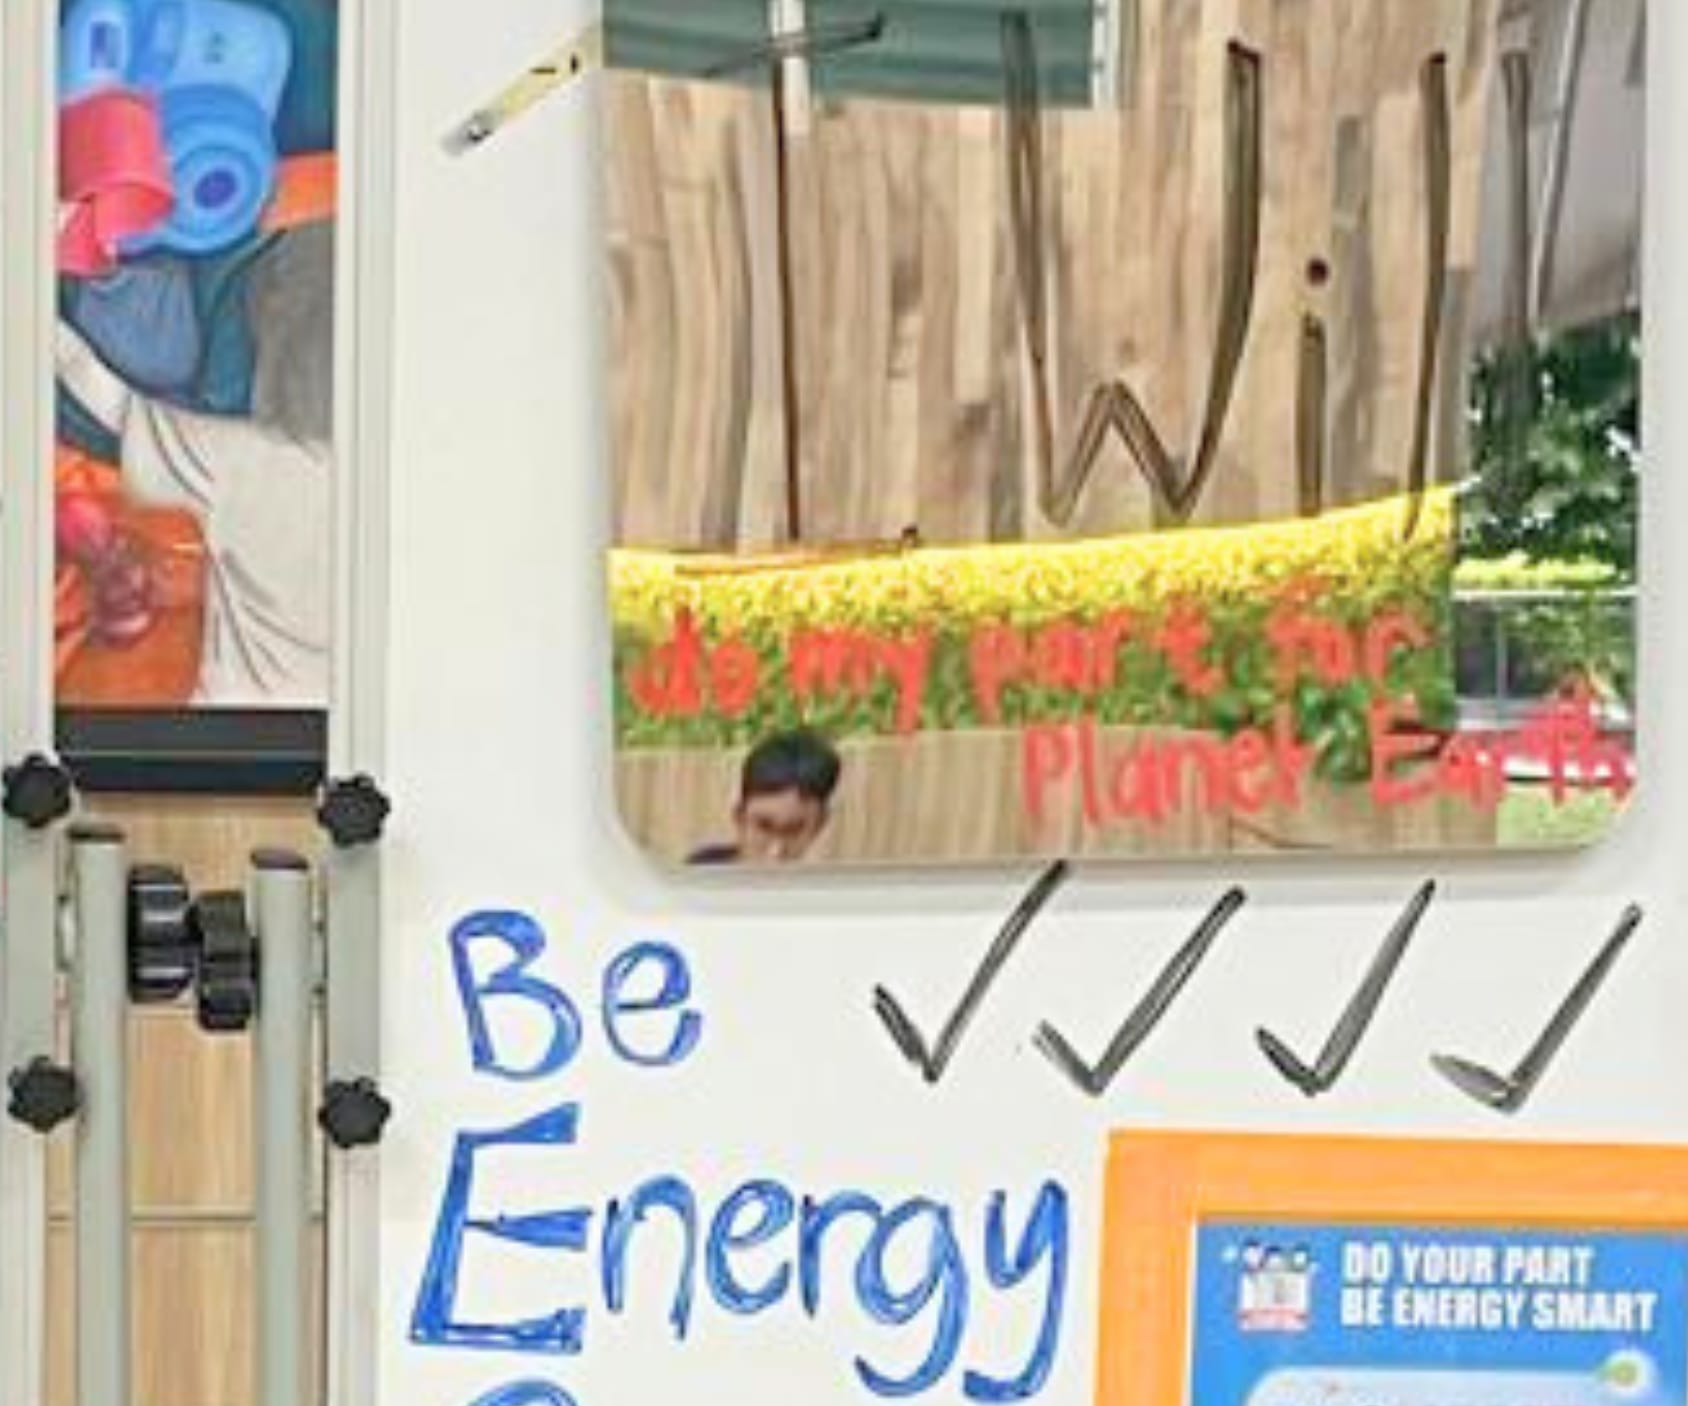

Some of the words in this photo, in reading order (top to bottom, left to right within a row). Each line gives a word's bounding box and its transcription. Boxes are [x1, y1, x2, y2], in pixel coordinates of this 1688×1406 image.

[630, 608, 758, 717] do
[786, 615, 932, 736] my
[970, 600, 1222, 718] part
[449, 908, 703, 1081] Be
[407, 1101, 1069, 1405] Energy
[1340, 1288, 1384, 1328] BE
[1393, 1289, 1529, 1330] ENERGY
[1532, 1291, 1657, 1332] SMART
[1341, 1241, 1393, 1286] DO
[1403, 1242, 1496, 1287] YOUR
[1503, 1246, 1593, 1287] PART
